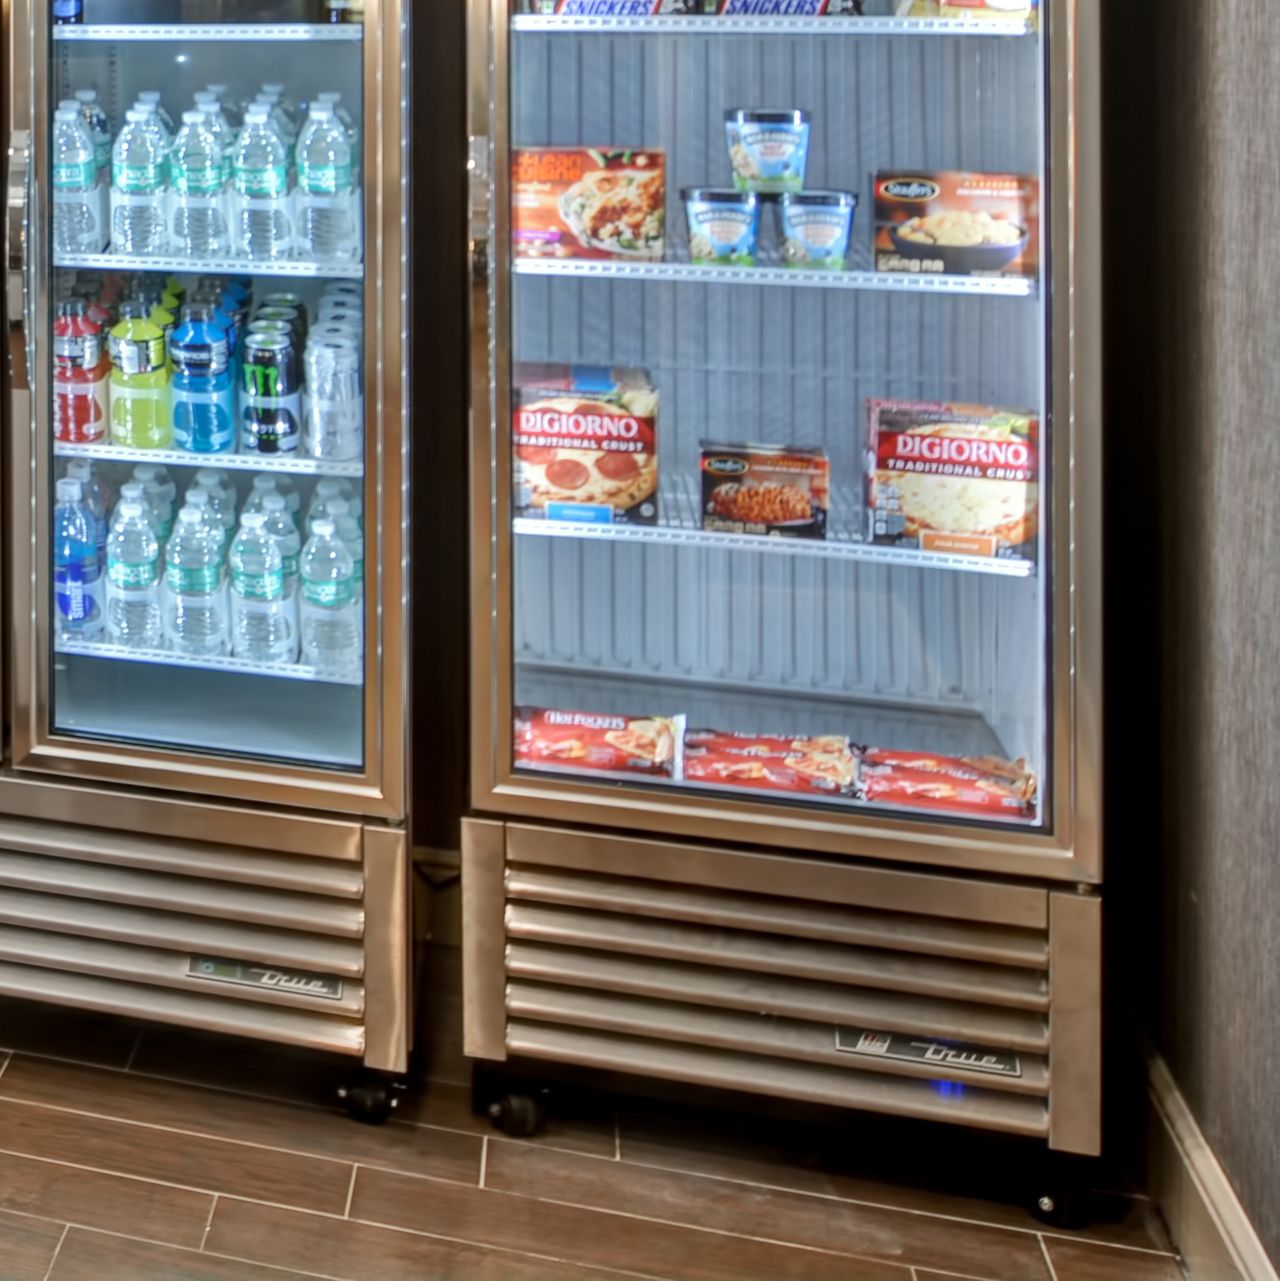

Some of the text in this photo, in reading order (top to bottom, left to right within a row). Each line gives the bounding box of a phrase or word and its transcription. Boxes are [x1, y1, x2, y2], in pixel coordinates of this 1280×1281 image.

[601, 440, 644, 452] CRUST
[886, 458, 1033, 481] TRADITIONAL CRUST
